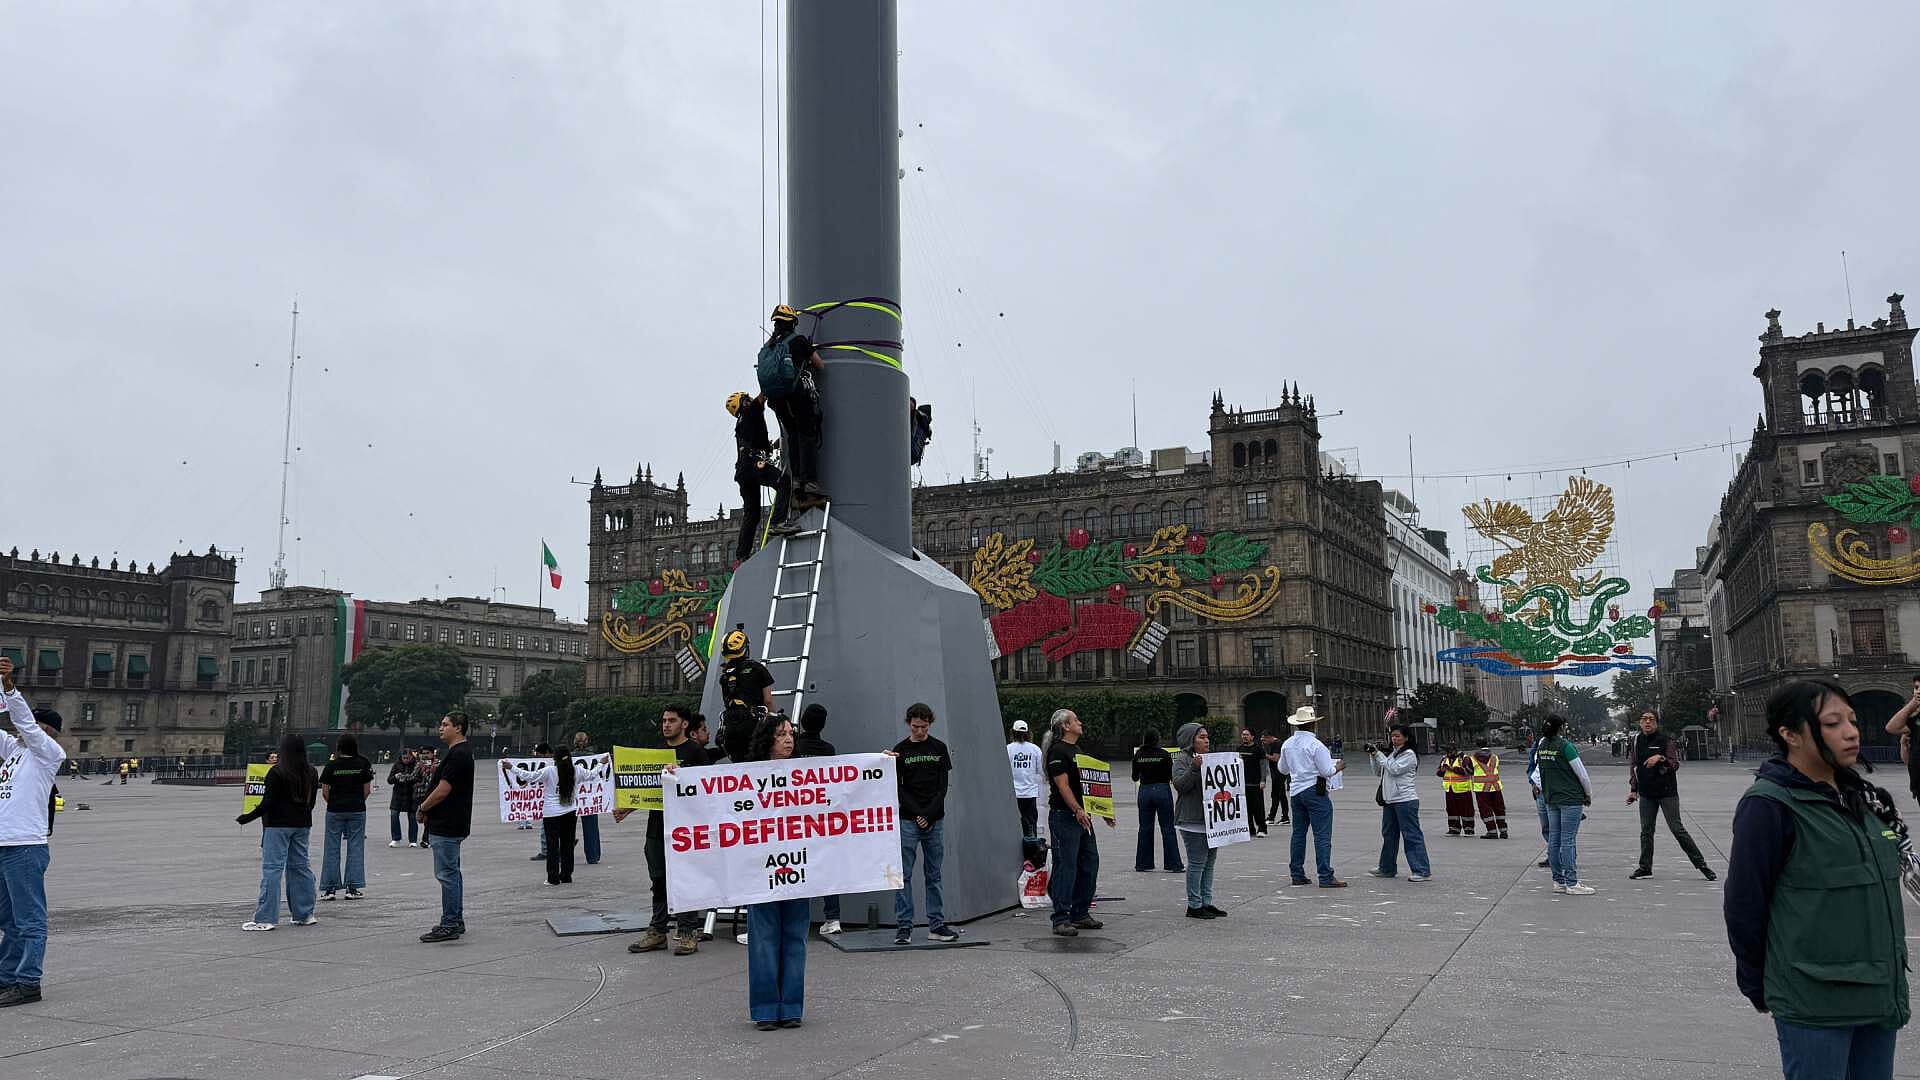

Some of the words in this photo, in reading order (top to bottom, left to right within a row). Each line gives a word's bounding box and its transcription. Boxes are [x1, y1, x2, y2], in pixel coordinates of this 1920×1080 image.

[676, 783, 697, 797] La
[700, 774, 754, 795] VIDA
[757, 777, 768, 792] y
[771, 774, 787, 788] la
[791, 766, 859, 787] SALUD
[862, 768, 883, 781] no
[1205, 759, 1241, 792] AQUÍ
[734, 797, 754, 812] se
[757, 787, 832, 809] VENDE,
[1208, 794, 1241, 830] ¡NO!
[671, 825, 711, 853] SE
[719, 806, 894, 848] DEFIENDE!!!
[765, 848, 807, 869] AQUÍ
[769, 868, 806, 890] ¡NO!
